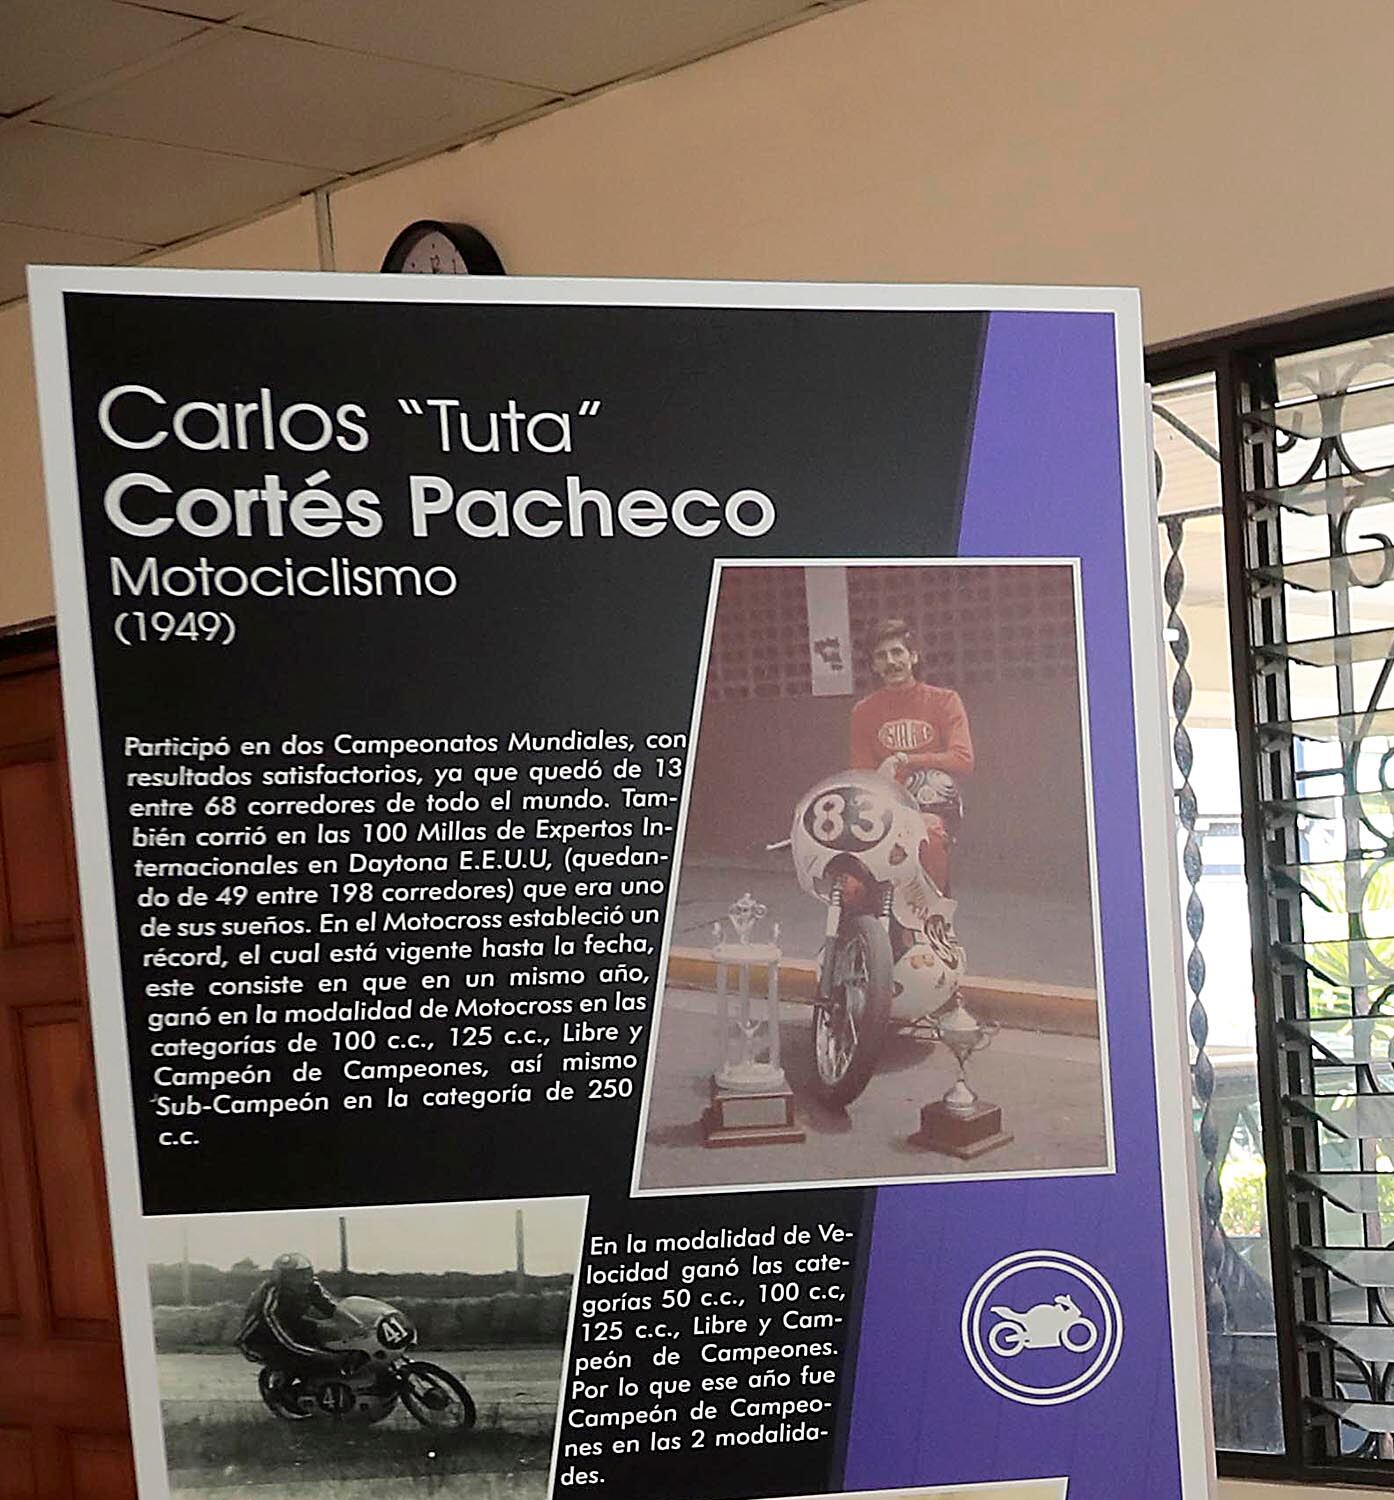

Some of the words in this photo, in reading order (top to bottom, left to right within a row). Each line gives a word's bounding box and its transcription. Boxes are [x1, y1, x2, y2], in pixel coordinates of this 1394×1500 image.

[99, 385, 368, 451] Carlos
[104, 470, 382, 537] Cortés
[410, 475, 775, 538] Pacheco
[110, 557, 456, 596] Motociclismo
[115, 611, 235, 645] (1949)
[125, 736, 230, 761] Participó
[241, 741, 270, 755] en
[282, 734, 324, 754] dos
[334, 734, 498, 758] Campeonatos
[508, 729, 634, 752] Mundiales,
[646, 734, 686, 749] con
[127, 765, 252, 786] resultados
[262, 763, 423, 785] satisfactorios,
[435, 768, 462, 787] ya
[474, 767, 518, 786] que
[529, 759, 602, 785] quedó
[613, 758, 641, 778] de
[656, 757, 682, 777] 13
[133, 827, 185, 847] bién
[196, 826, 266, 846] corrió
[277, 831, 306, 844] en
[318, 823, 350, 843] las
[364, 823, 407, 842] 100
[417, 820, 486, 841] Millas
[497, 819, 525, 840] de
[536, 819, 632, 843] Expertos
[643, 817, 673, 836] In-
[812, 793, 885, 842] 83
[134, 854, 298, 877] ternacionales
[308, 860, 337, 874] en
[349, 853, 448, 877] Daytona
[460, 849, 552, 871] E.E.U.U,
[565, 845, 668, 872] (quedan-
[143, 945, 228, 968] récord,
[239, 944, 260, 965] el
[270, 943, 320, 964] cual
[330, 942, 377, 962] está
[386, 941, 472, 965] vigente
[482, 937, 544, 957] hasta
[554, 935, 574, 955] la
[584, 933, 654, 955] fecha,
[154, 1065, 271, 1090] Campeón
[293, 1061, 322, 1082] de
[344, 1060, 488, 1083] Campeones,
[511, 1053, 543, 1073] así
[563, 1052, 637, 1071] mismo
[156, 1092, 328, 1117] Sub-Campeón
[344, 1095, 372, 1109] en
[388, 1087, 408, 1107] la
[423, 1083, 531, 1109] categoría
[546, 1080, 574, 1101] de
[588, 1078, 632, 1099] 250
[159, 1131, 199, 1145] c.c.
[591, 1236, 617, 1255] En
[627, 1234, 646, 1253] la
[656, 1226, 775, 1252] modalidad
[784, 1225, 811, 1245] de
[818, 1223, 853, 1242] Ve-
[587, 1260, 668, 1284] locidad
[682, 1258, 739, 1283] ganó
[752, 1255, 782, 1275] las
[795, 1254, 849, 1272] cate-
[582, 1292, 652, 1318] gorías
[662, 1289, 691, 1308] 50
[701, 1292, 744, 1307] c.c.,
[759, 1282, 799, 1302] 100
[809, 1286, 845, 1301] c.c,
[381, 1316, 408, 1344] 41
[582, 1321, 622, 1341] 125
[636, 1324, 679, 1339] c.c.,
[694, 1314, 747, 1335] Libre
[759, 1318, 772, 1336] y
[783, 1310, 842, 1329] Cam-
[575, 1350, 631, 1376] peón
[653, 1346, 680, 1366] de
[701, 1342, 838, 1365] Campeones.
[572, 1381, 609, 1399] Por
[619, 1377, 638, 1396] lo
[650, 1380, 691, 1399] que
[702, 1377, 738, 1391] ese
[748, 1369, 790, 1388] año
[800, 1365, 835, 1384] fue
[568, 1404, 677, 1430] Campeón
[690, 1400, 717, 1420] de
[730, 1398, 832, 1419] Campeo-
[565, 1442, 602, 1457] nes
[612, 1440, 639, 1453] en
[651, 1432, 681, 1451] las
[691, 1429, 705, 1448] 2
[716, 1422, 828, 1446] modalida-
[561, 1466, 604, 1486] des.
